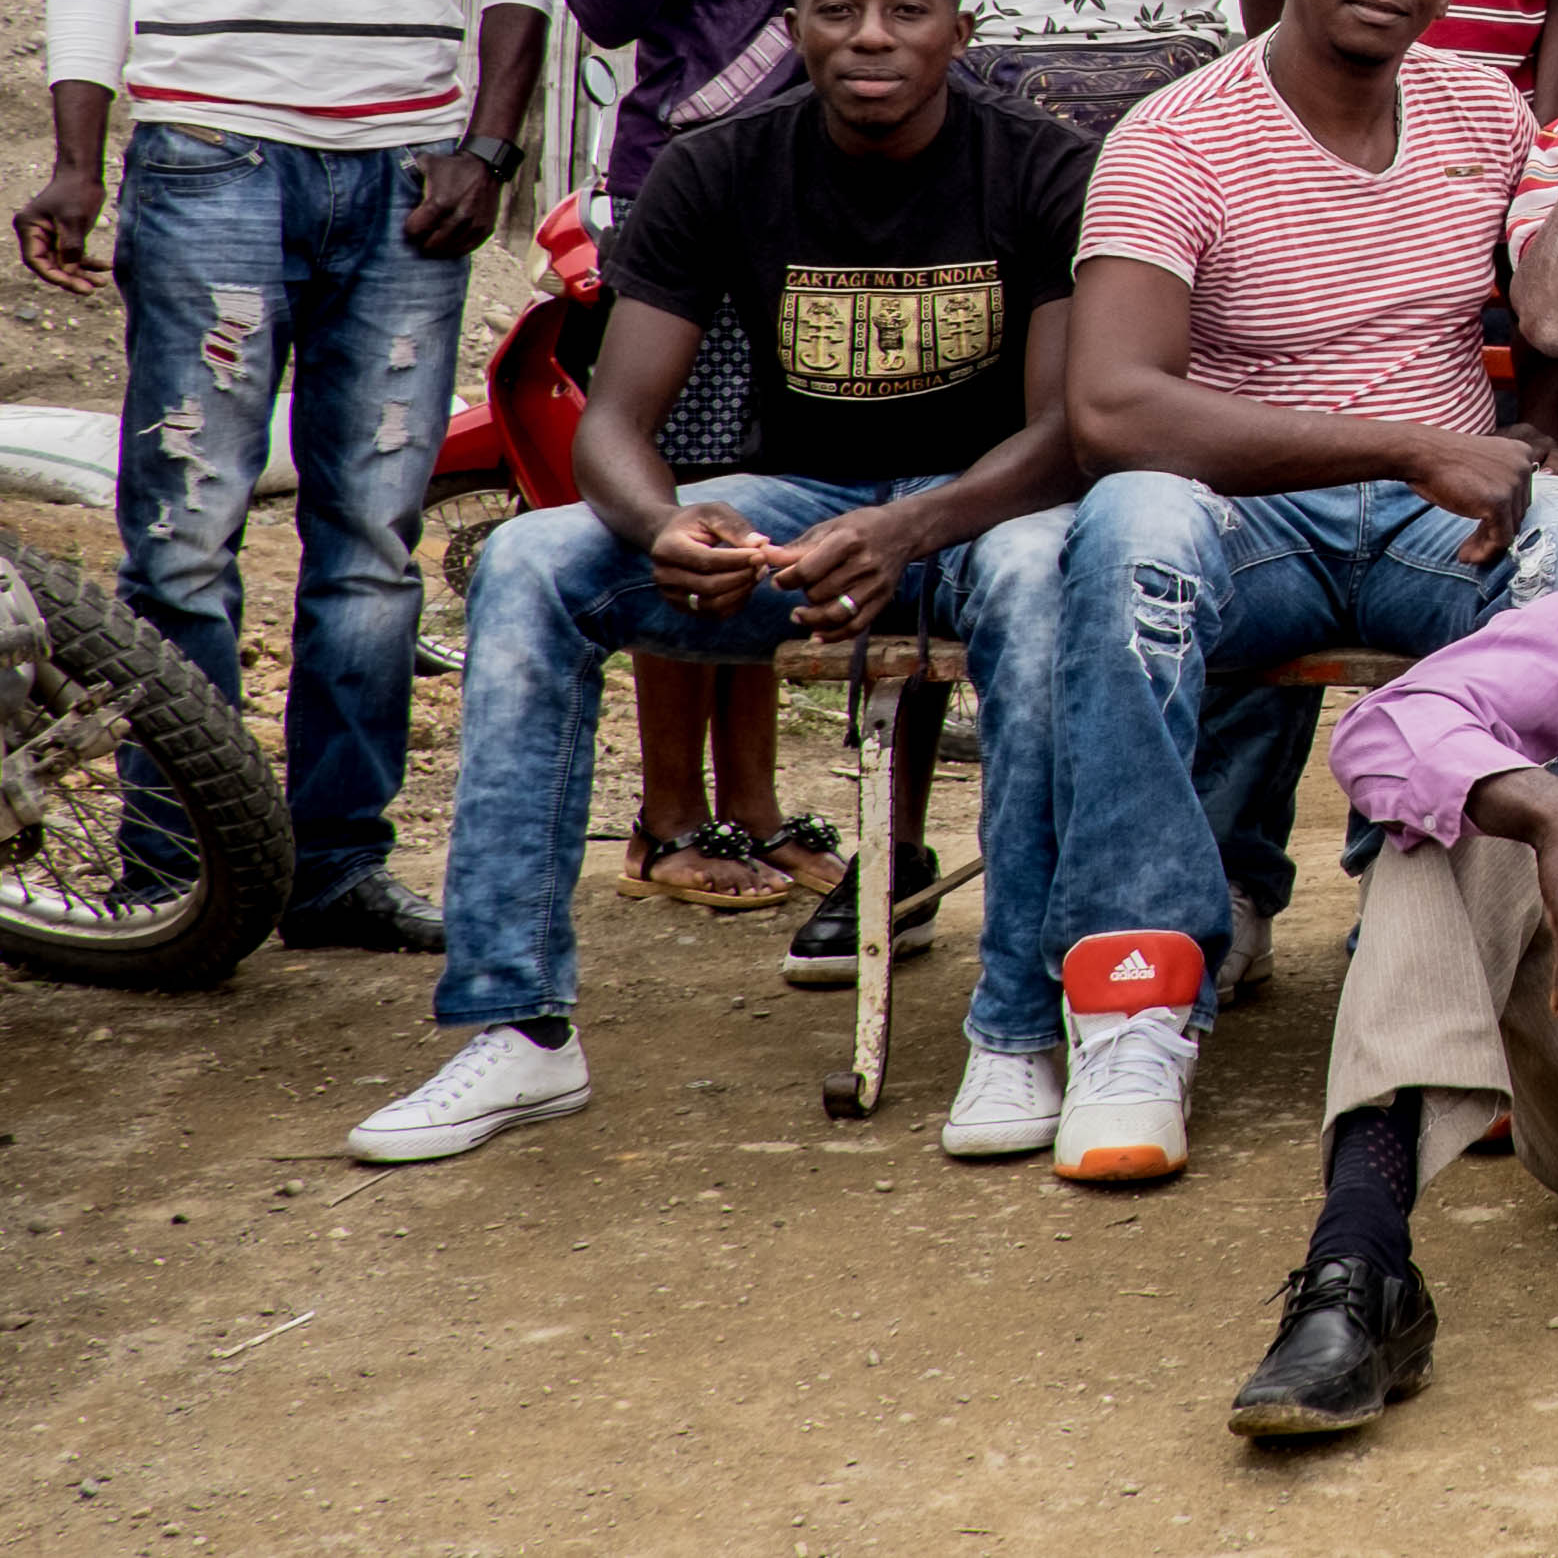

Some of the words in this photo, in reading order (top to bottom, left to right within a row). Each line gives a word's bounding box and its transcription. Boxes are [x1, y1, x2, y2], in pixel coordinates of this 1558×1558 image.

[903, 271, 929, 288] DE
[932, 265, 998, 286] INDIAS
[839, 374, 944, 397] COLOMBIA
[1109, 966, 1156, 983] adidas
